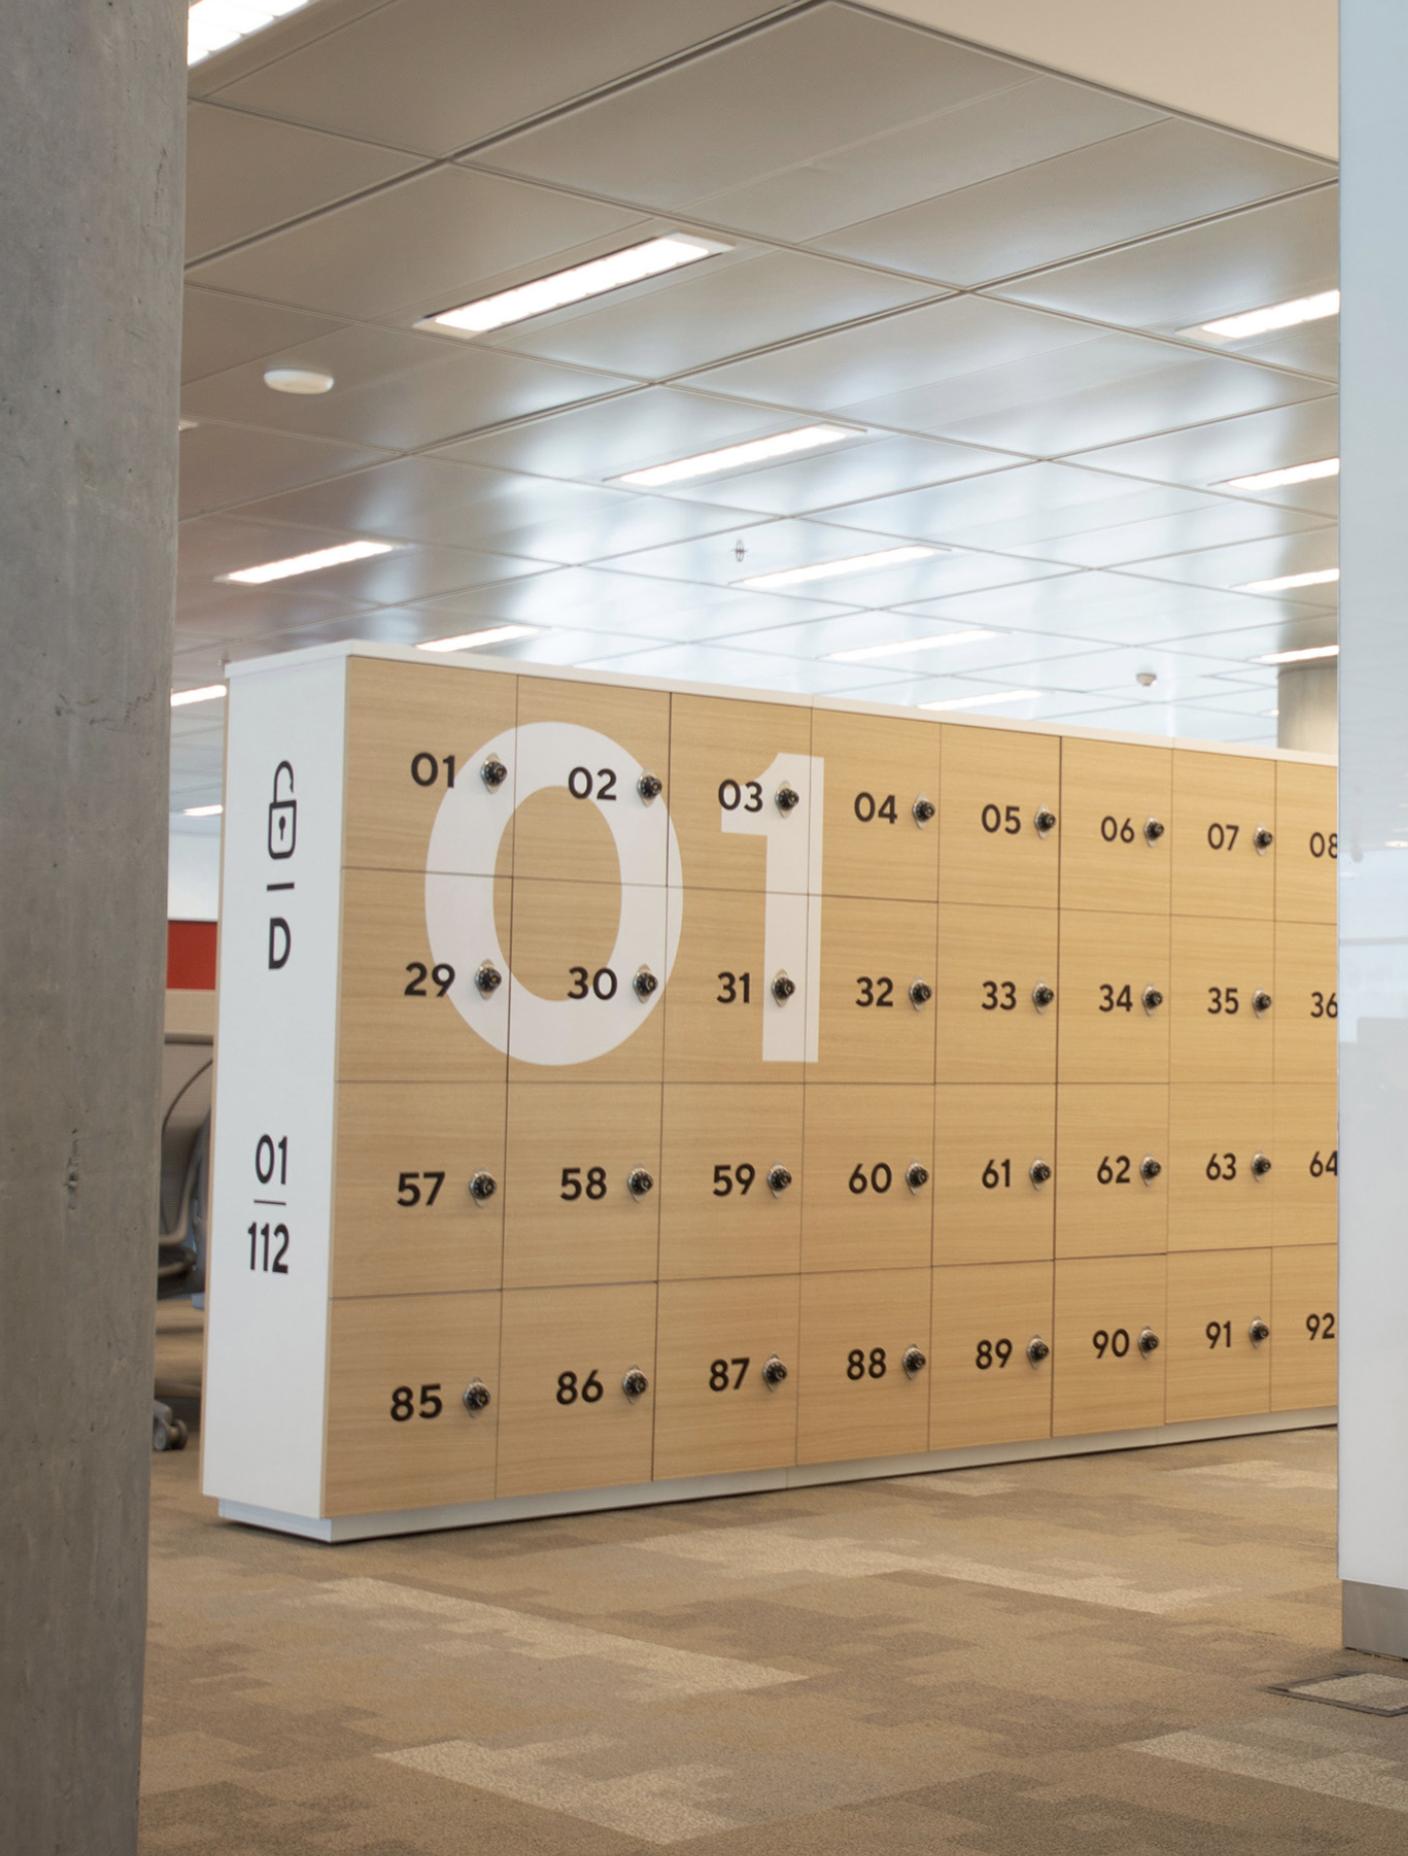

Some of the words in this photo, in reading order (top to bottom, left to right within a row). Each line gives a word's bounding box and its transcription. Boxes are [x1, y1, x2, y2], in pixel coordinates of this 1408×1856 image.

[410, 752, 455, 788] 01
[568, 766, 617, 801] 02
[718, 779, 763, 812] 03
[854, 792, 898, 824] 04
[981, 804, 1021, 835] 05
[1101, 816, 1135, 844] 06
[1208, 823, 1239, 851] 07
[1310, 832, 1338, 859] 08
[424, 721, 824, 1065] 01
[268, 917, 291, 970] D
[403, 961, 455, 998] 29
[567, 966, 618, 1001] 30
[716, 971, 750, 1004] 31
[855, 976, 894, 1008] 32
[981, 980, 1017, 1011] 33
[1099, 984, 1133, 1012] 34
[1207, 987, 1239, 1015] 35
[1311, 991, 1338, 1018] 36
[255, 1134, 287, 1185] 01
[981, 1158, 1011, 1189] 61
[1096, 1155, 1131, 1185] 62
[1206, 1153, 1237, 1181] 63
[1309, 1150, 1338, 1178] 64
[396, 1170, 446, 1208] 57
[560, 1166, 607, 1202] 58
[712, 1163, 756, 1197] 59
[848, 1162, 892, 1195] 60
[247, 1222, 289, 1274] 112
[1205, 1320, 1231, 1350] 91
[1306, 1312, 1335, 1341] 92
[975, 1338, 1013, 1371] 89
[1092, 1328, 1130, 1359] 90
[708, 1356, 751, 1393] 87
[846, 1347, 887, 1381] 88
[389, 1382, 444, 1423] 85
[555, 1369, 604, 1406] 86
